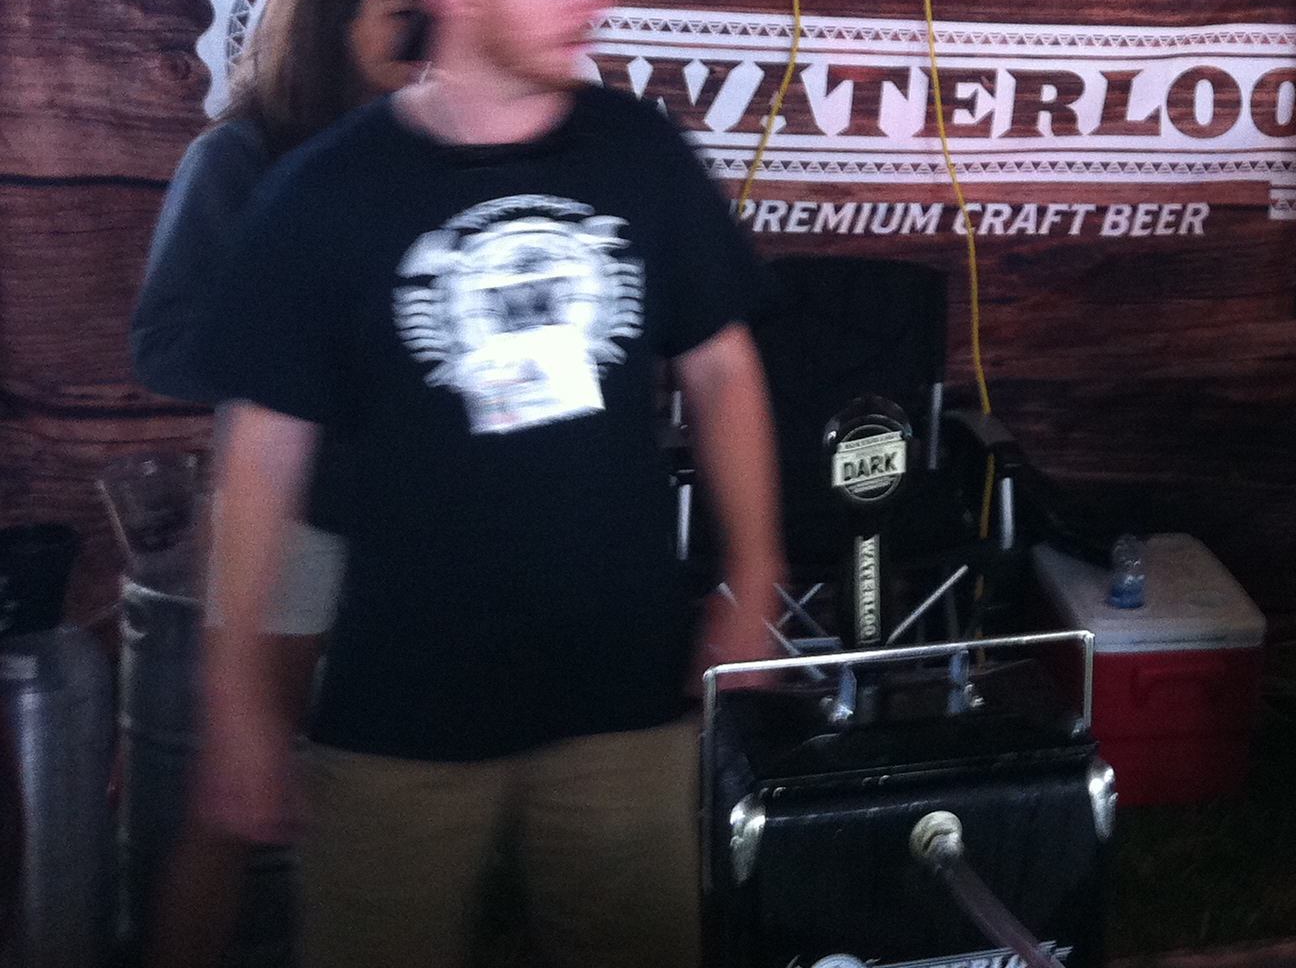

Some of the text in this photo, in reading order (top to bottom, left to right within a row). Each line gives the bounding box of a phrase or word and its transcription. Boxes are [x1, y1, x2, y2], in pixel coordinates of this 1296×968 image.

[730, 198, 1211, 236] PREMIUM CRAFT BEER
[843, 451, 898, 482] DARK
[858, 537, 876, 637] WATERLOO
